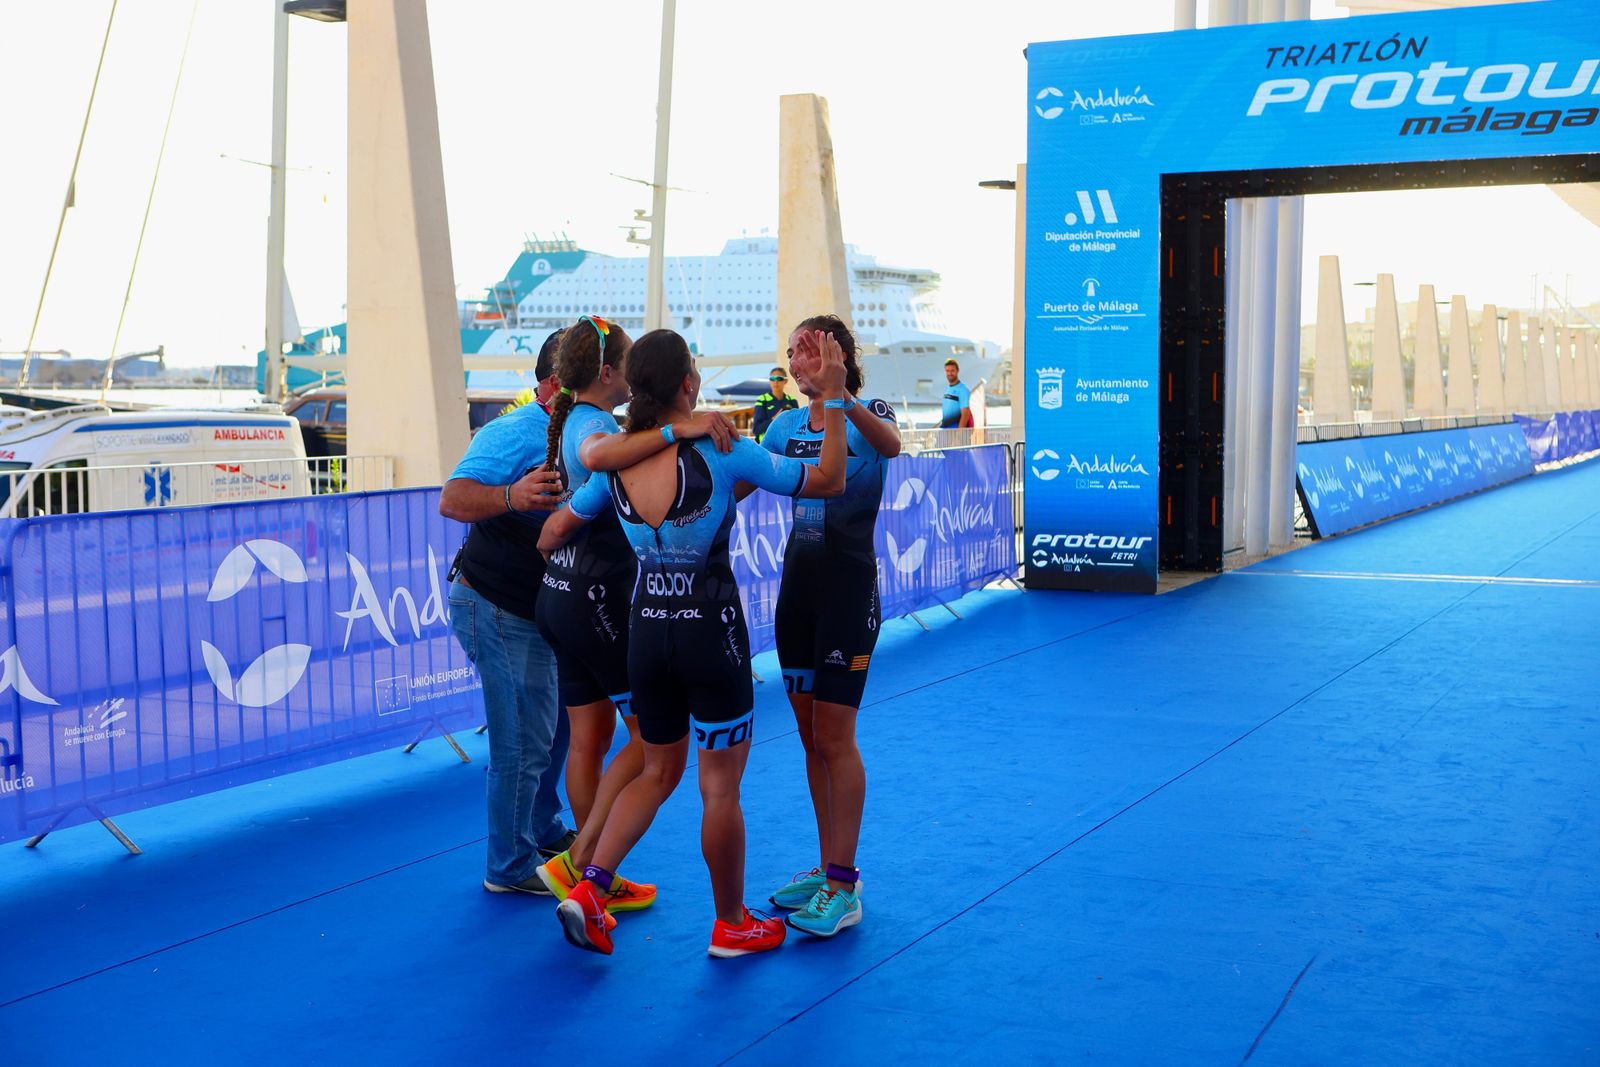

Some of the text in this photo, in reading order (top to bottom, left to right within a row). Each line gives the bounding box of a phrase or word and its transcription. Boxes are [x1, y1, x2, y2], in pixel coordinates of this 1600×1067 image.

[1265, 32, 1428, 69] TRIATLÓN
[1070, 85, 1155, 111] Andalucía
[1399, 106, 1600, 136] málaga
[1045, 229, 1140, 242] Diputación Provincial
[1068, 241, 1116, 253] de Málaga
[1044, 301, 1139, 314] Puerto de Málaga
[1076, 378, 1149, 391] Ayuntamiento
[1076, 390, 1130, 403] de Málaga
[214, 429, 286, 441] AMBULANCIA
[1067, 453, 1149, 476] Andalucía
[1051, 552, 1095, 566] Andalucía
[1111, 552, 1138, 561] FETRI
[646, 572, 695, 596] GODOY
[410, 666, 475, 689] UNIÓN EUROPEA
[64, 723, 95, 737] Andalucía
[64, 728, 126, 746] se mueve con Europa
